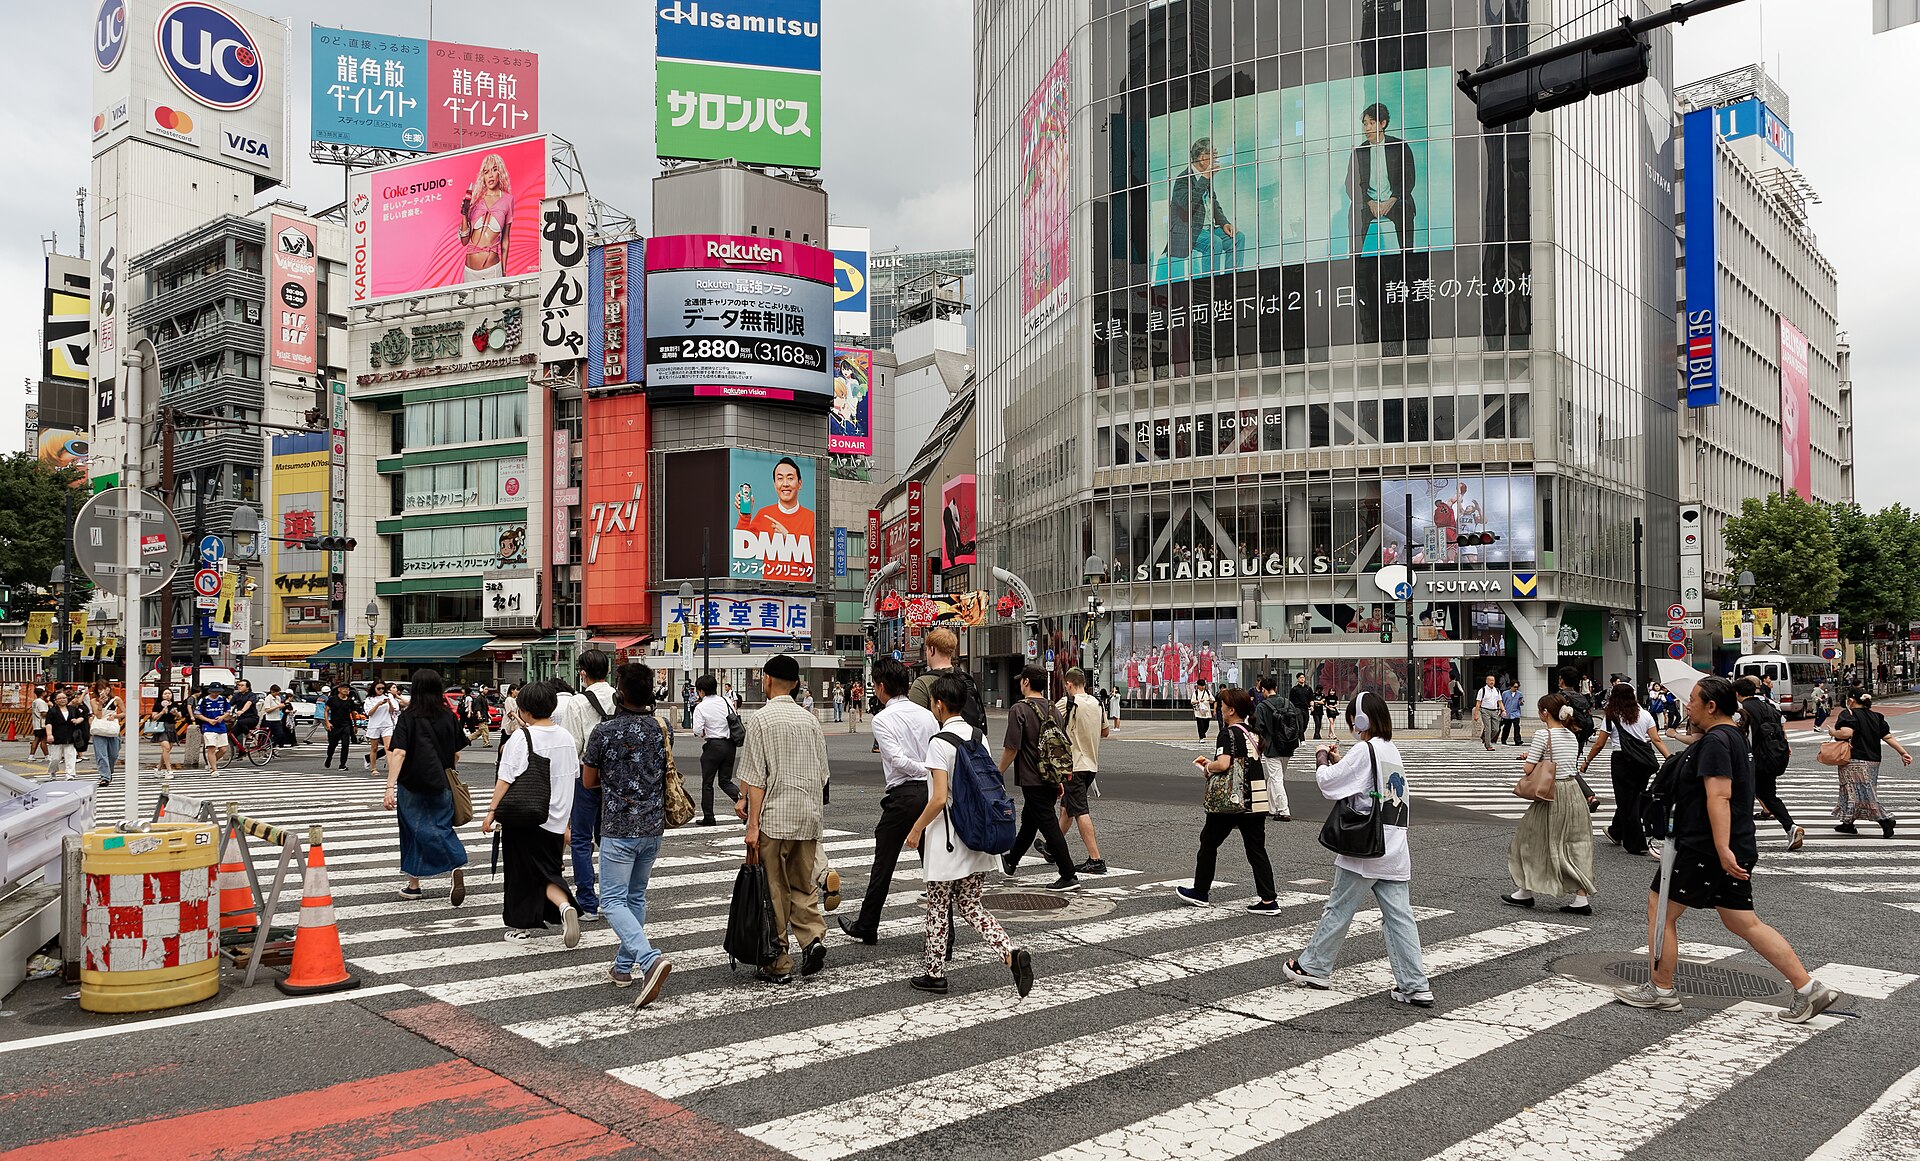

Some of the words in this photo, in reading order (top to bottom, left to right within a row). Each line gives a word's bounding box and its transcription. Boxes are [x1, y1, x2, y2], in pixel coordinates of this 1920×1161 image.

[98, 7, 124, 51] UC
[659, 0, 818, 37] Hisamitsu
[171, 19, 253, 87] UC
[337, 55, 405, 88] 龍角散
[452, 68, 517, 101] 龍角散
[112, 104, 127, 121] VISA
[327, 85, 417, 117] ダイレクト
[443, 97, 529, 129] ダイレクト
[667, 90, 811, 138] サロンパス
[338, 116, 373, 126] スティック
[156, 127, 192, 142] mastercard
[224, 131, 269, 158] VISA
[404, 131, 423, 143] 生薬
[1645, 162, 1671, 195] TSUTAYA
[383, 185, 408, 200] Coke
[355, 220, 367, 234] G
[707, 241, 783, 264] Rakuten
[355, 237, 367, 301] KAROL
[543, 199, 584, 356] もんじゃ
[696, 279, 734, 291] Rakuten
[735, 278, 792, 296] 最強プラン
[604, 247, 623, 377] 三千里薬品
[684, 298, 756, 308] 全通信キャリアの中で
[758, 300, 804, 313] どこよりも安い
[281, 311, 306, 328] B1F
[682, 308, 805, 337] データ無制限
[281, 327, 307, 344] B2F
[682, 339, 740, 359] 2,880
[1688, 309, 1713, 392] SEIBU
[101, 390, 113, 408] 7F
[723, 387, 748, 395] Rakuten
[748, 388, 767, 396] Vision
[1156, 421, 1204, 437] SHARE
[1220, 414, 1281, 430] LOUNGE
[275, 461, 310, 470] Matsumoto
[284, 509, 316, 549] 薬
[588, 483, 643, 564] クスリ
[909, 489, 920, 548] カラオケ
[732, 529, 813, 564] DMM
[732, 561, 814, 577] オンラインクリニック
[1137, 555, 1328, 581] STARBUCKS
[485, 583, 503, 591] うなぎ
[1426, 580, 1501, 593] TSUTAYA
[671, 602, 807, 628] 大盛堂書店
